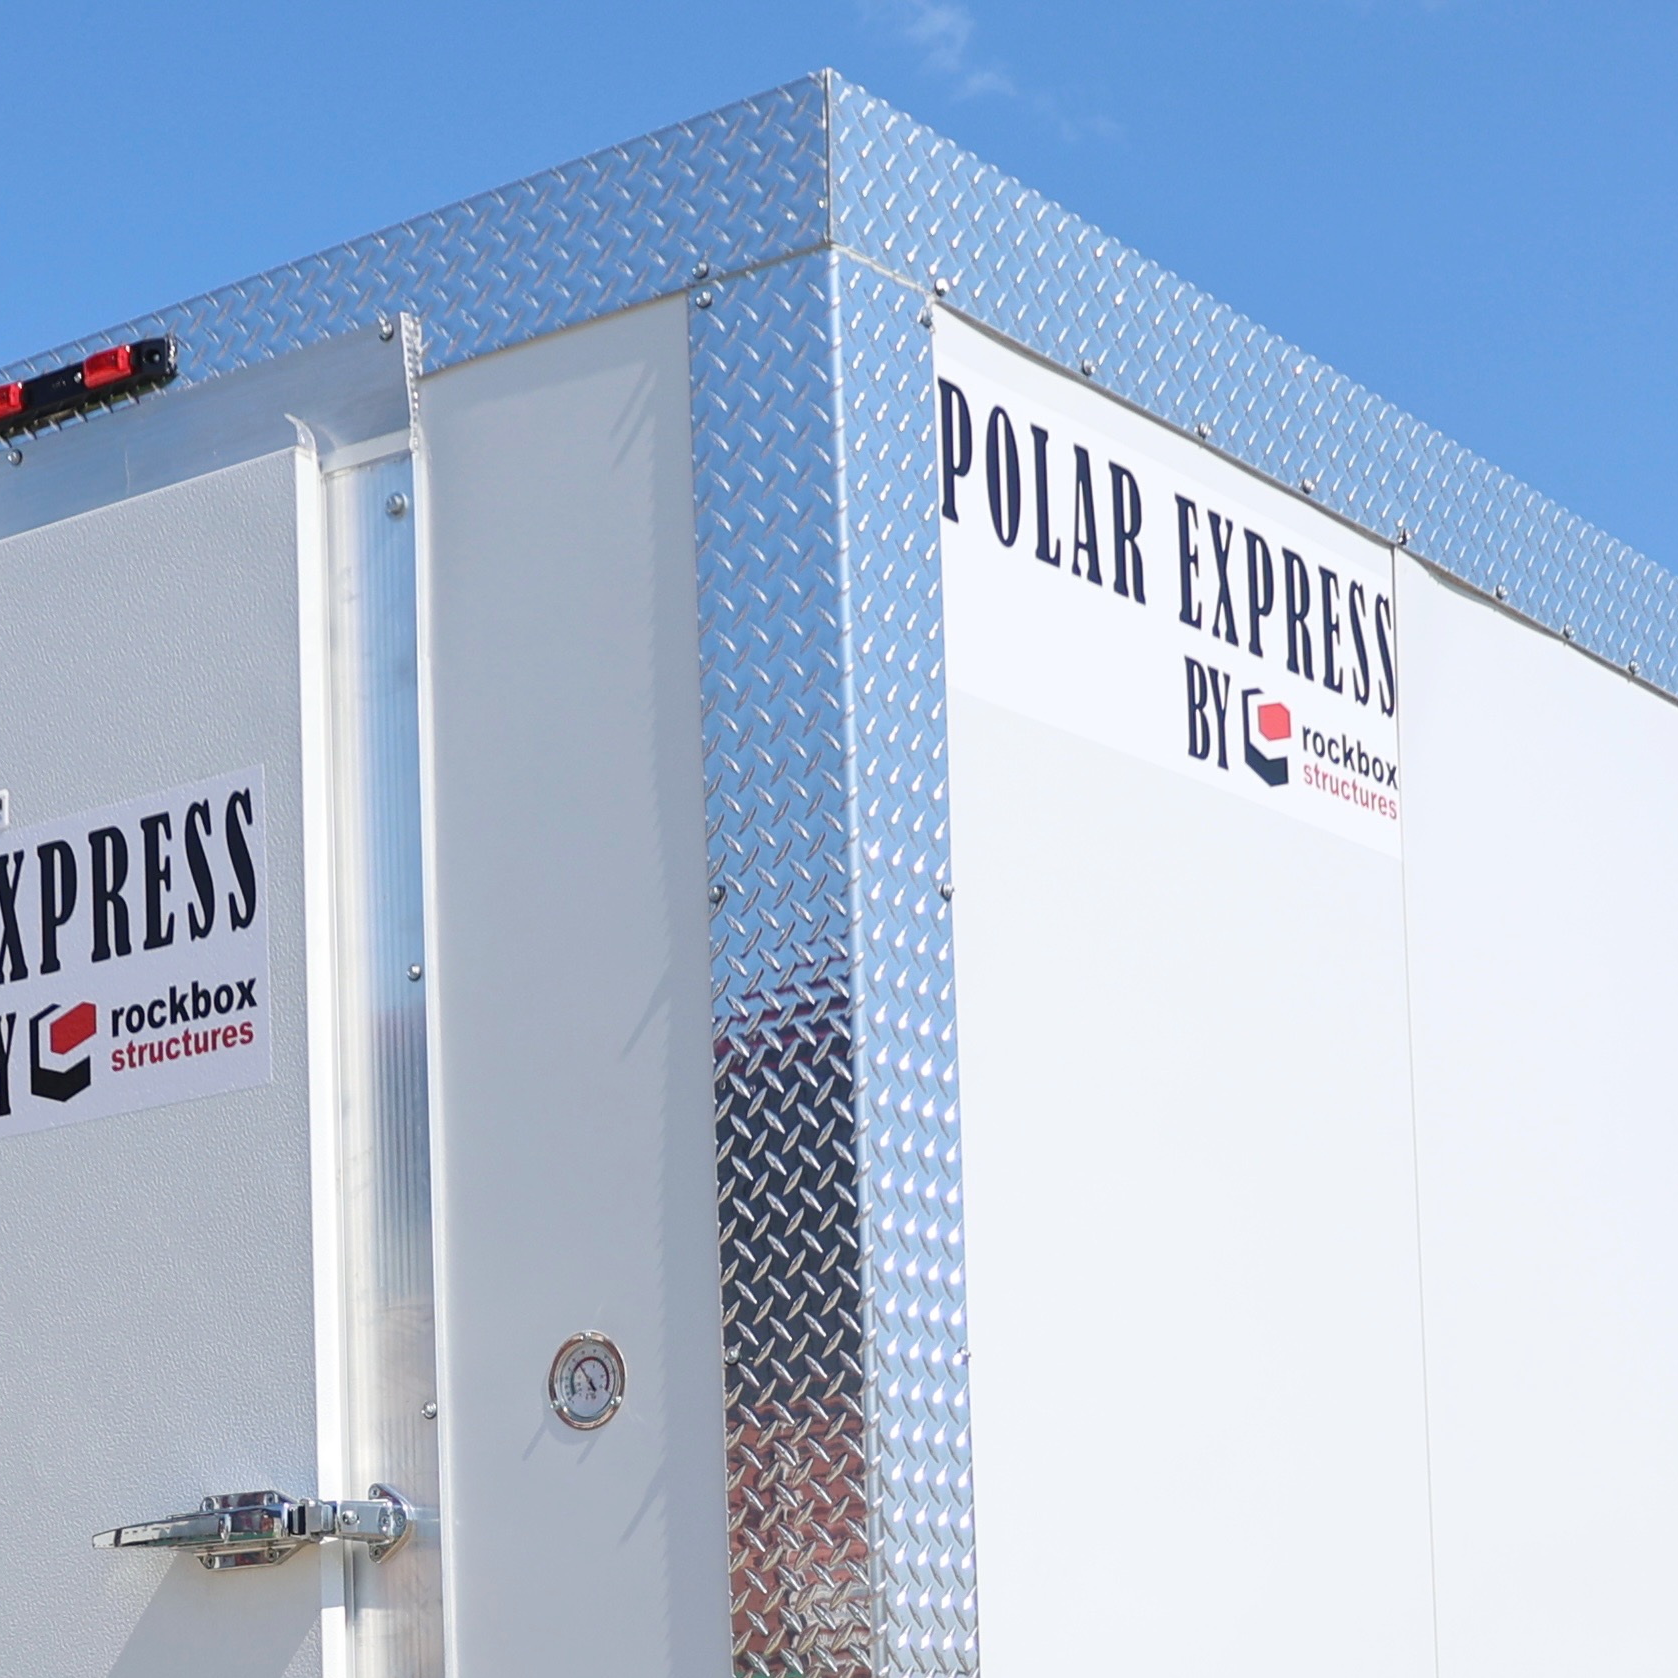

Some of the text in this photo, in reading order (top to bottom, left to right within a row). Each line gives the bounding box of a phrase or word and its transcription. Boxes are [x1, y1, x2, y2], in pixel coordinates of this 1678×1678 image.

[937, 375, 1396, 719] POLAR EXPRESS
[1183, 654, 1232, 771] BY
[1301, 725, 1399, 790] rockbox
[1302, 762, 1398, 821] structures
[110, 977, 259, 1038] rockbox
[110, 1021, 256, 1073] structures
